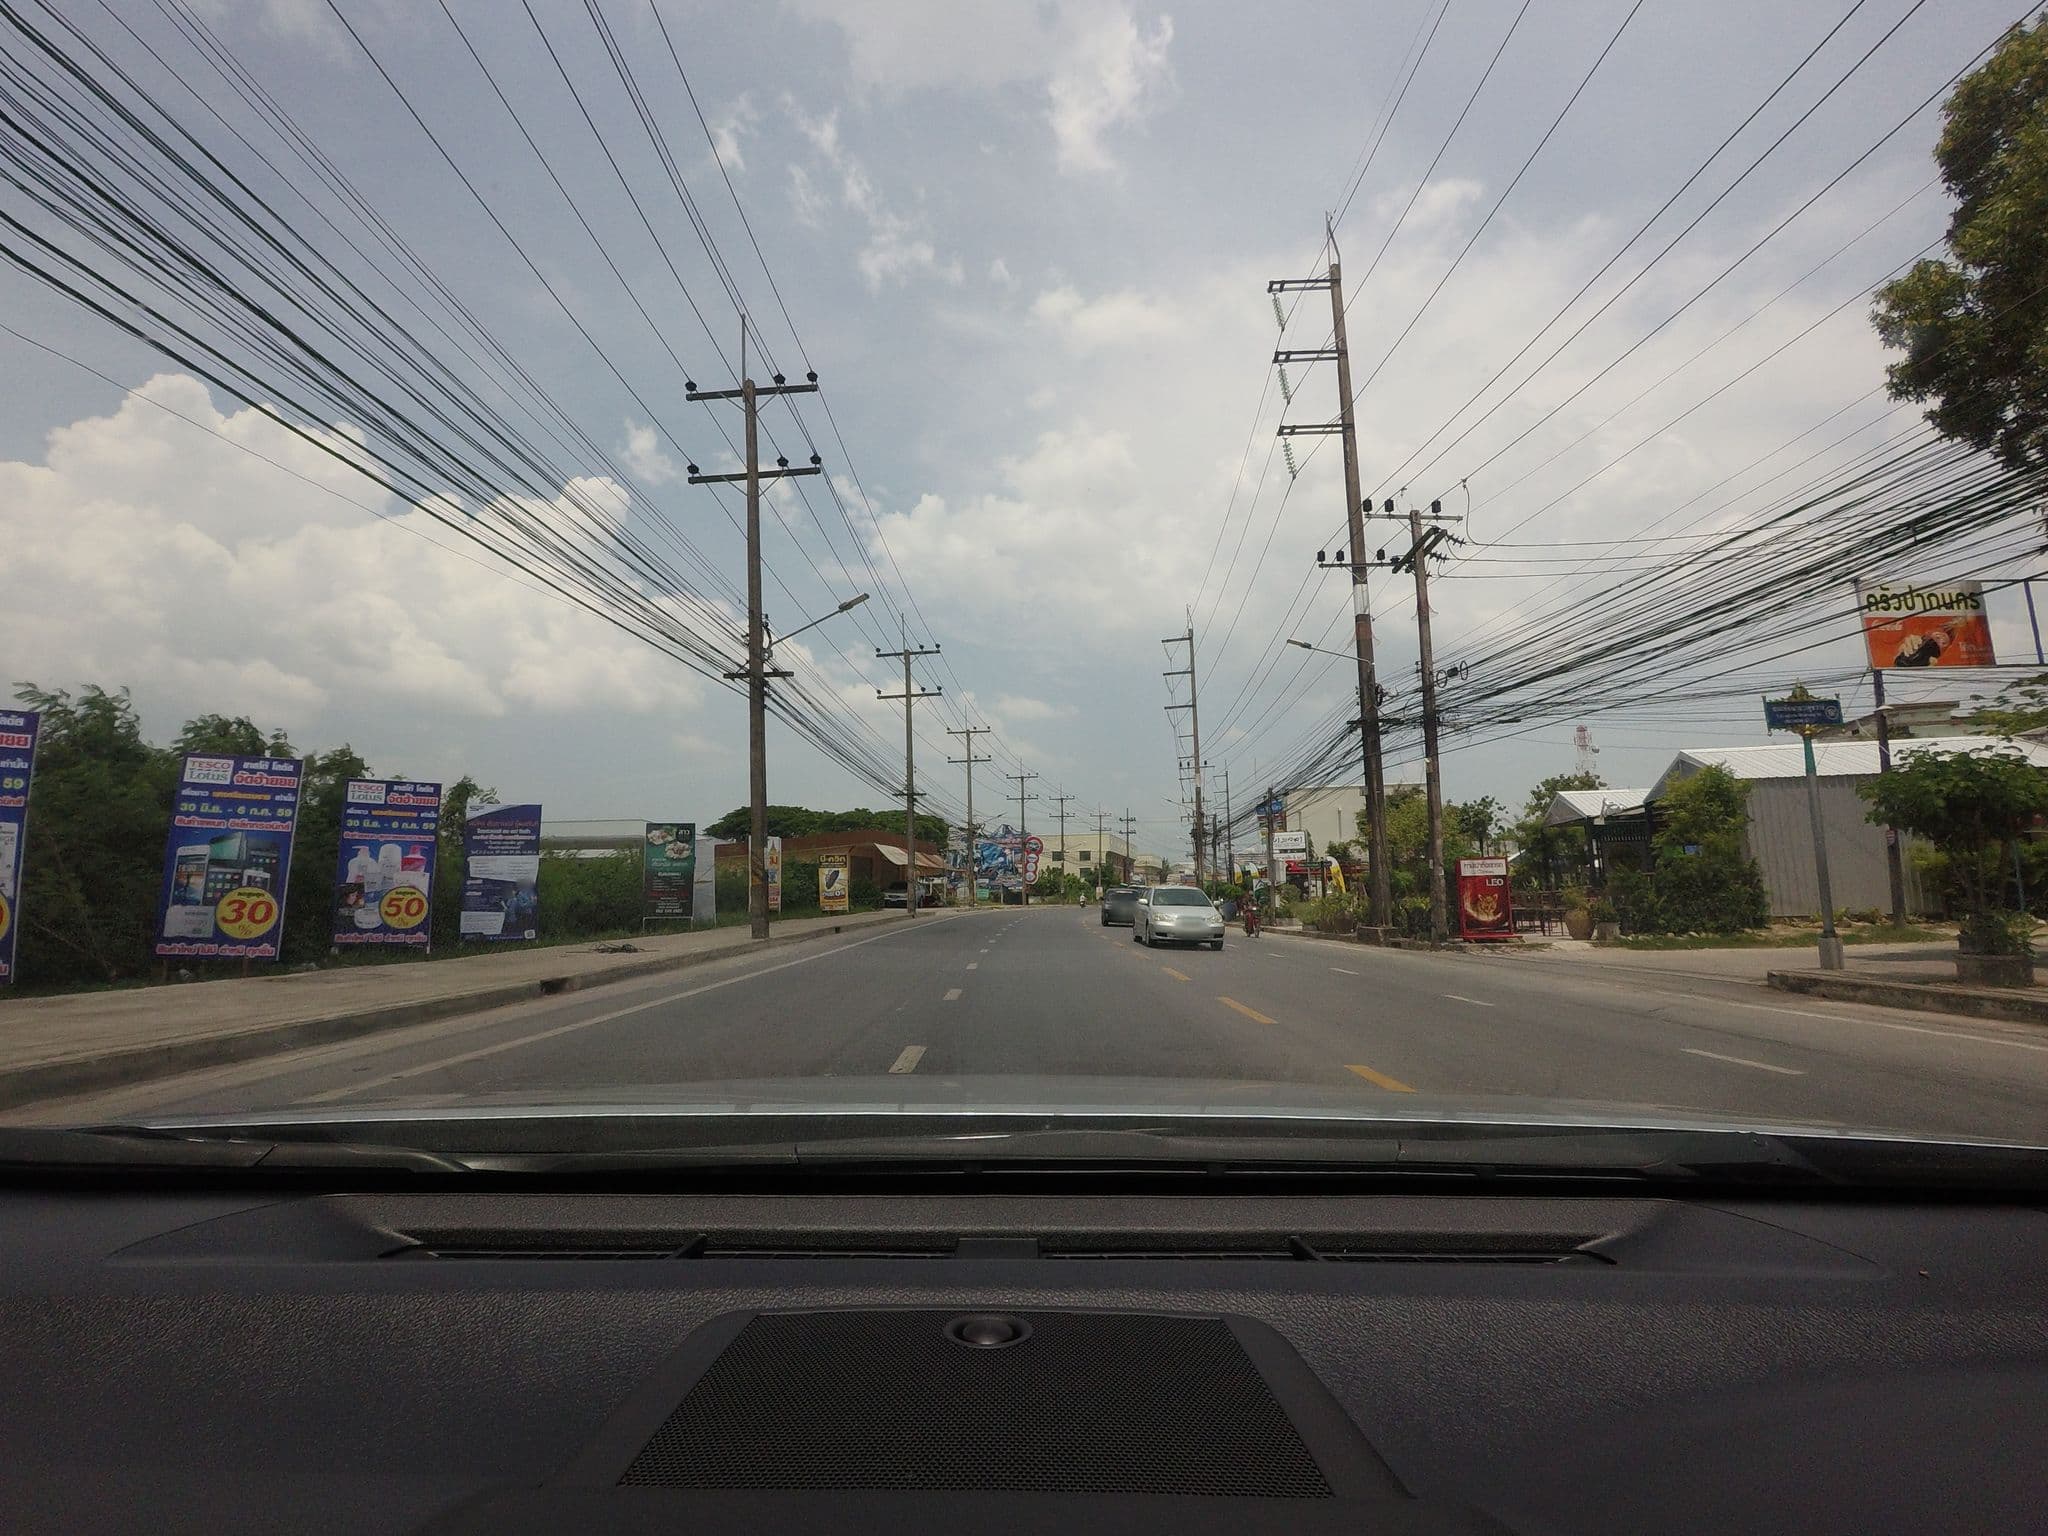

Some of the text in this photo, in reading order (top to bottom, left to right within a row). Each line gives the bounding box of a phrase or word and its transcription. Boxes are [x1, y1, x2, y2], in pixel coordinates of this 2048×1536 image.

[190, 760, 232, 769] TESCO
[189, 770, 229, 780] Lotus
[3, 777, 24, 789] 59
[350, 784, 384, 792] TESCO
[351, 792, 383, 801] Lotus
[180, 803, 196, 811] 30
[276, 808, 293, 817] 59
[1485, 878, 1504, 887] LEO
[221, 899, 274, 924] 30
[384, 897, 425, 917] 50
